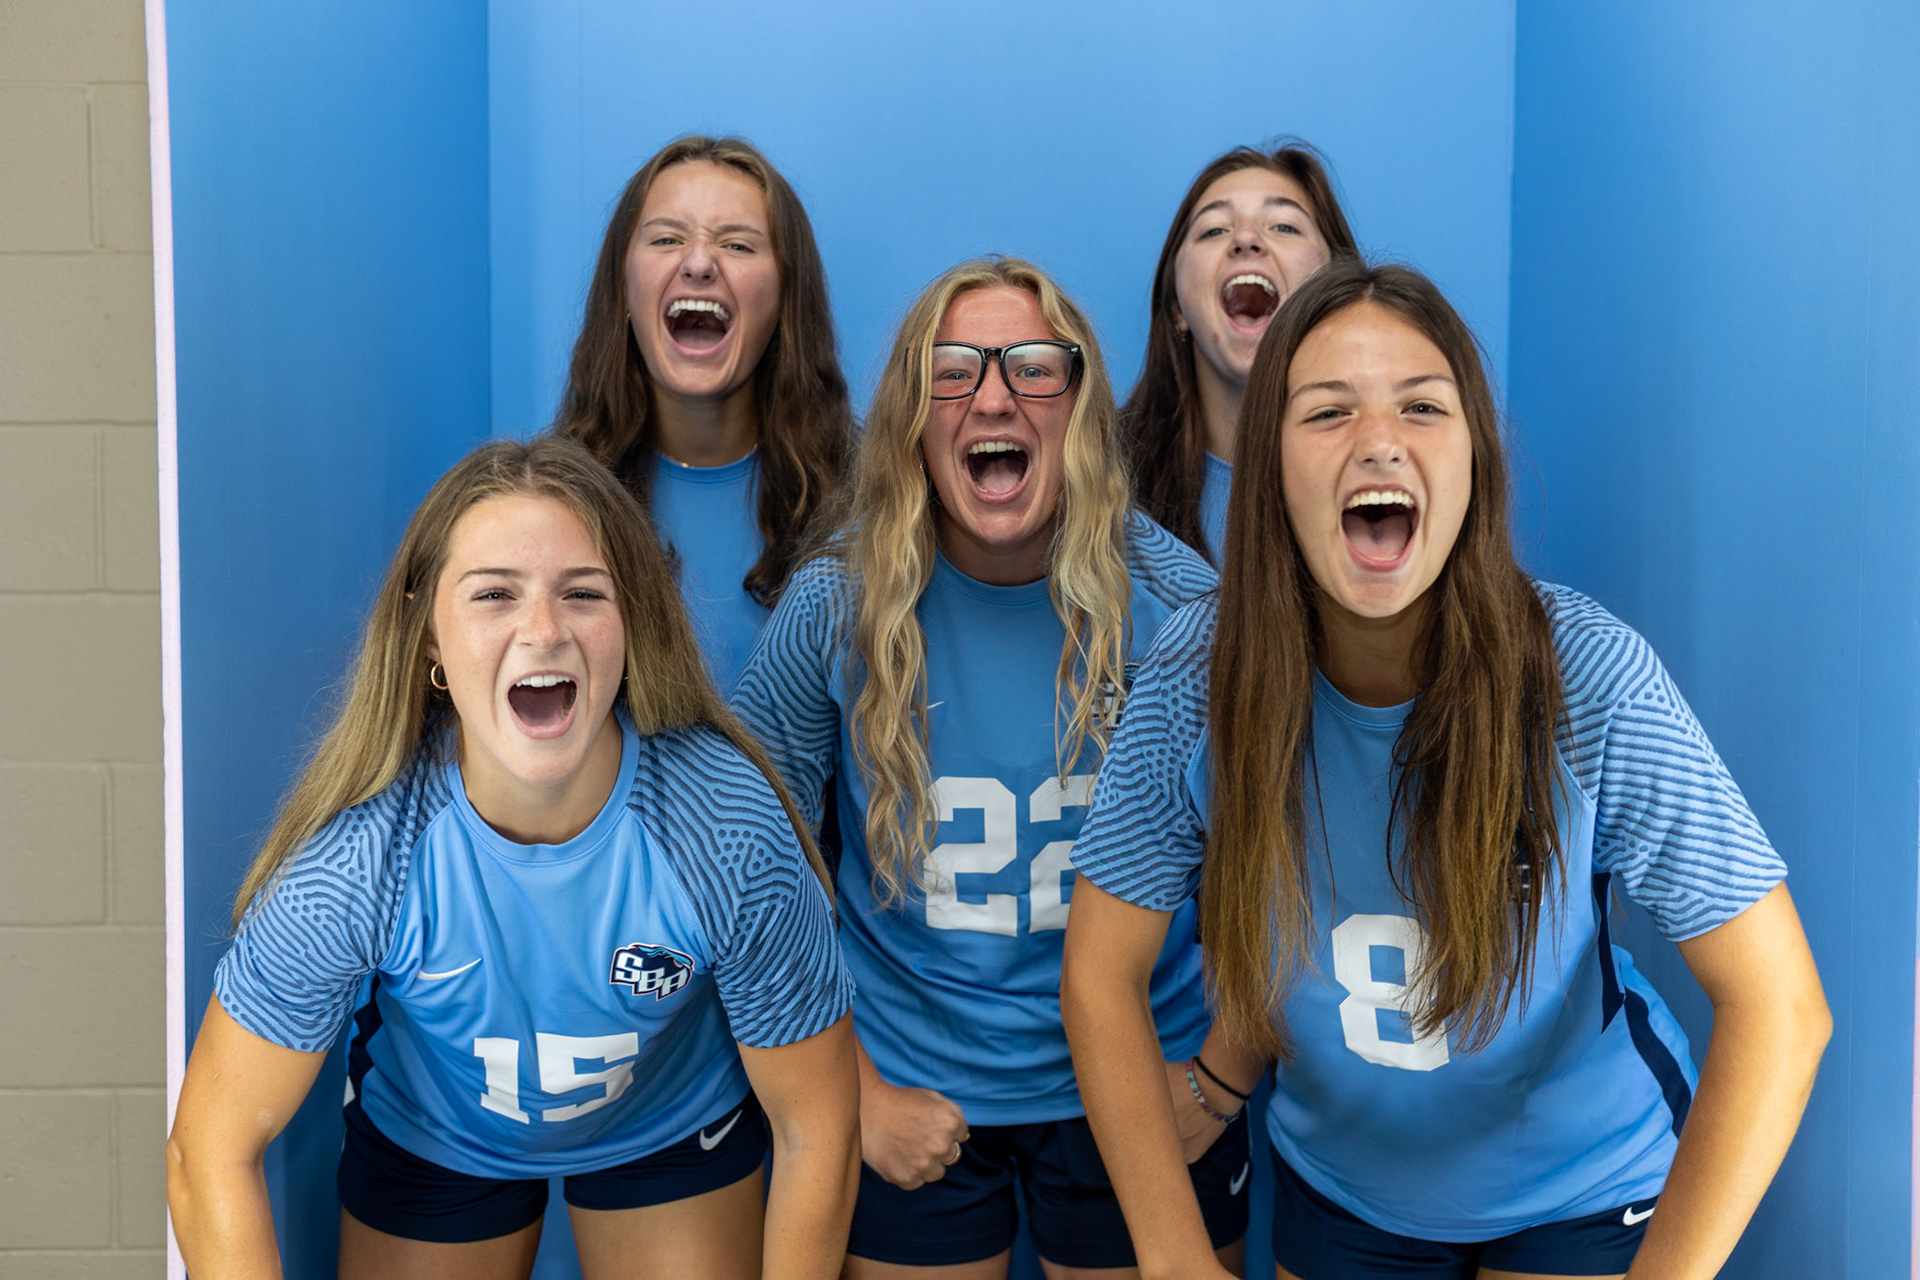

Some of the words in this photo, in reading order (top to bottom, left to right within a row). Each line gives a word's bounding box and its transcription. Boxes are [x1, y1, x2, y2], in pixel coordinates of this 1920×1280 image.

[923, 774, 1095, 937] 22
[615, 952, 688, 997] SBA
[1332, 914, 1449, 1071] 8
[474, 1032, 639, 1125] 15
